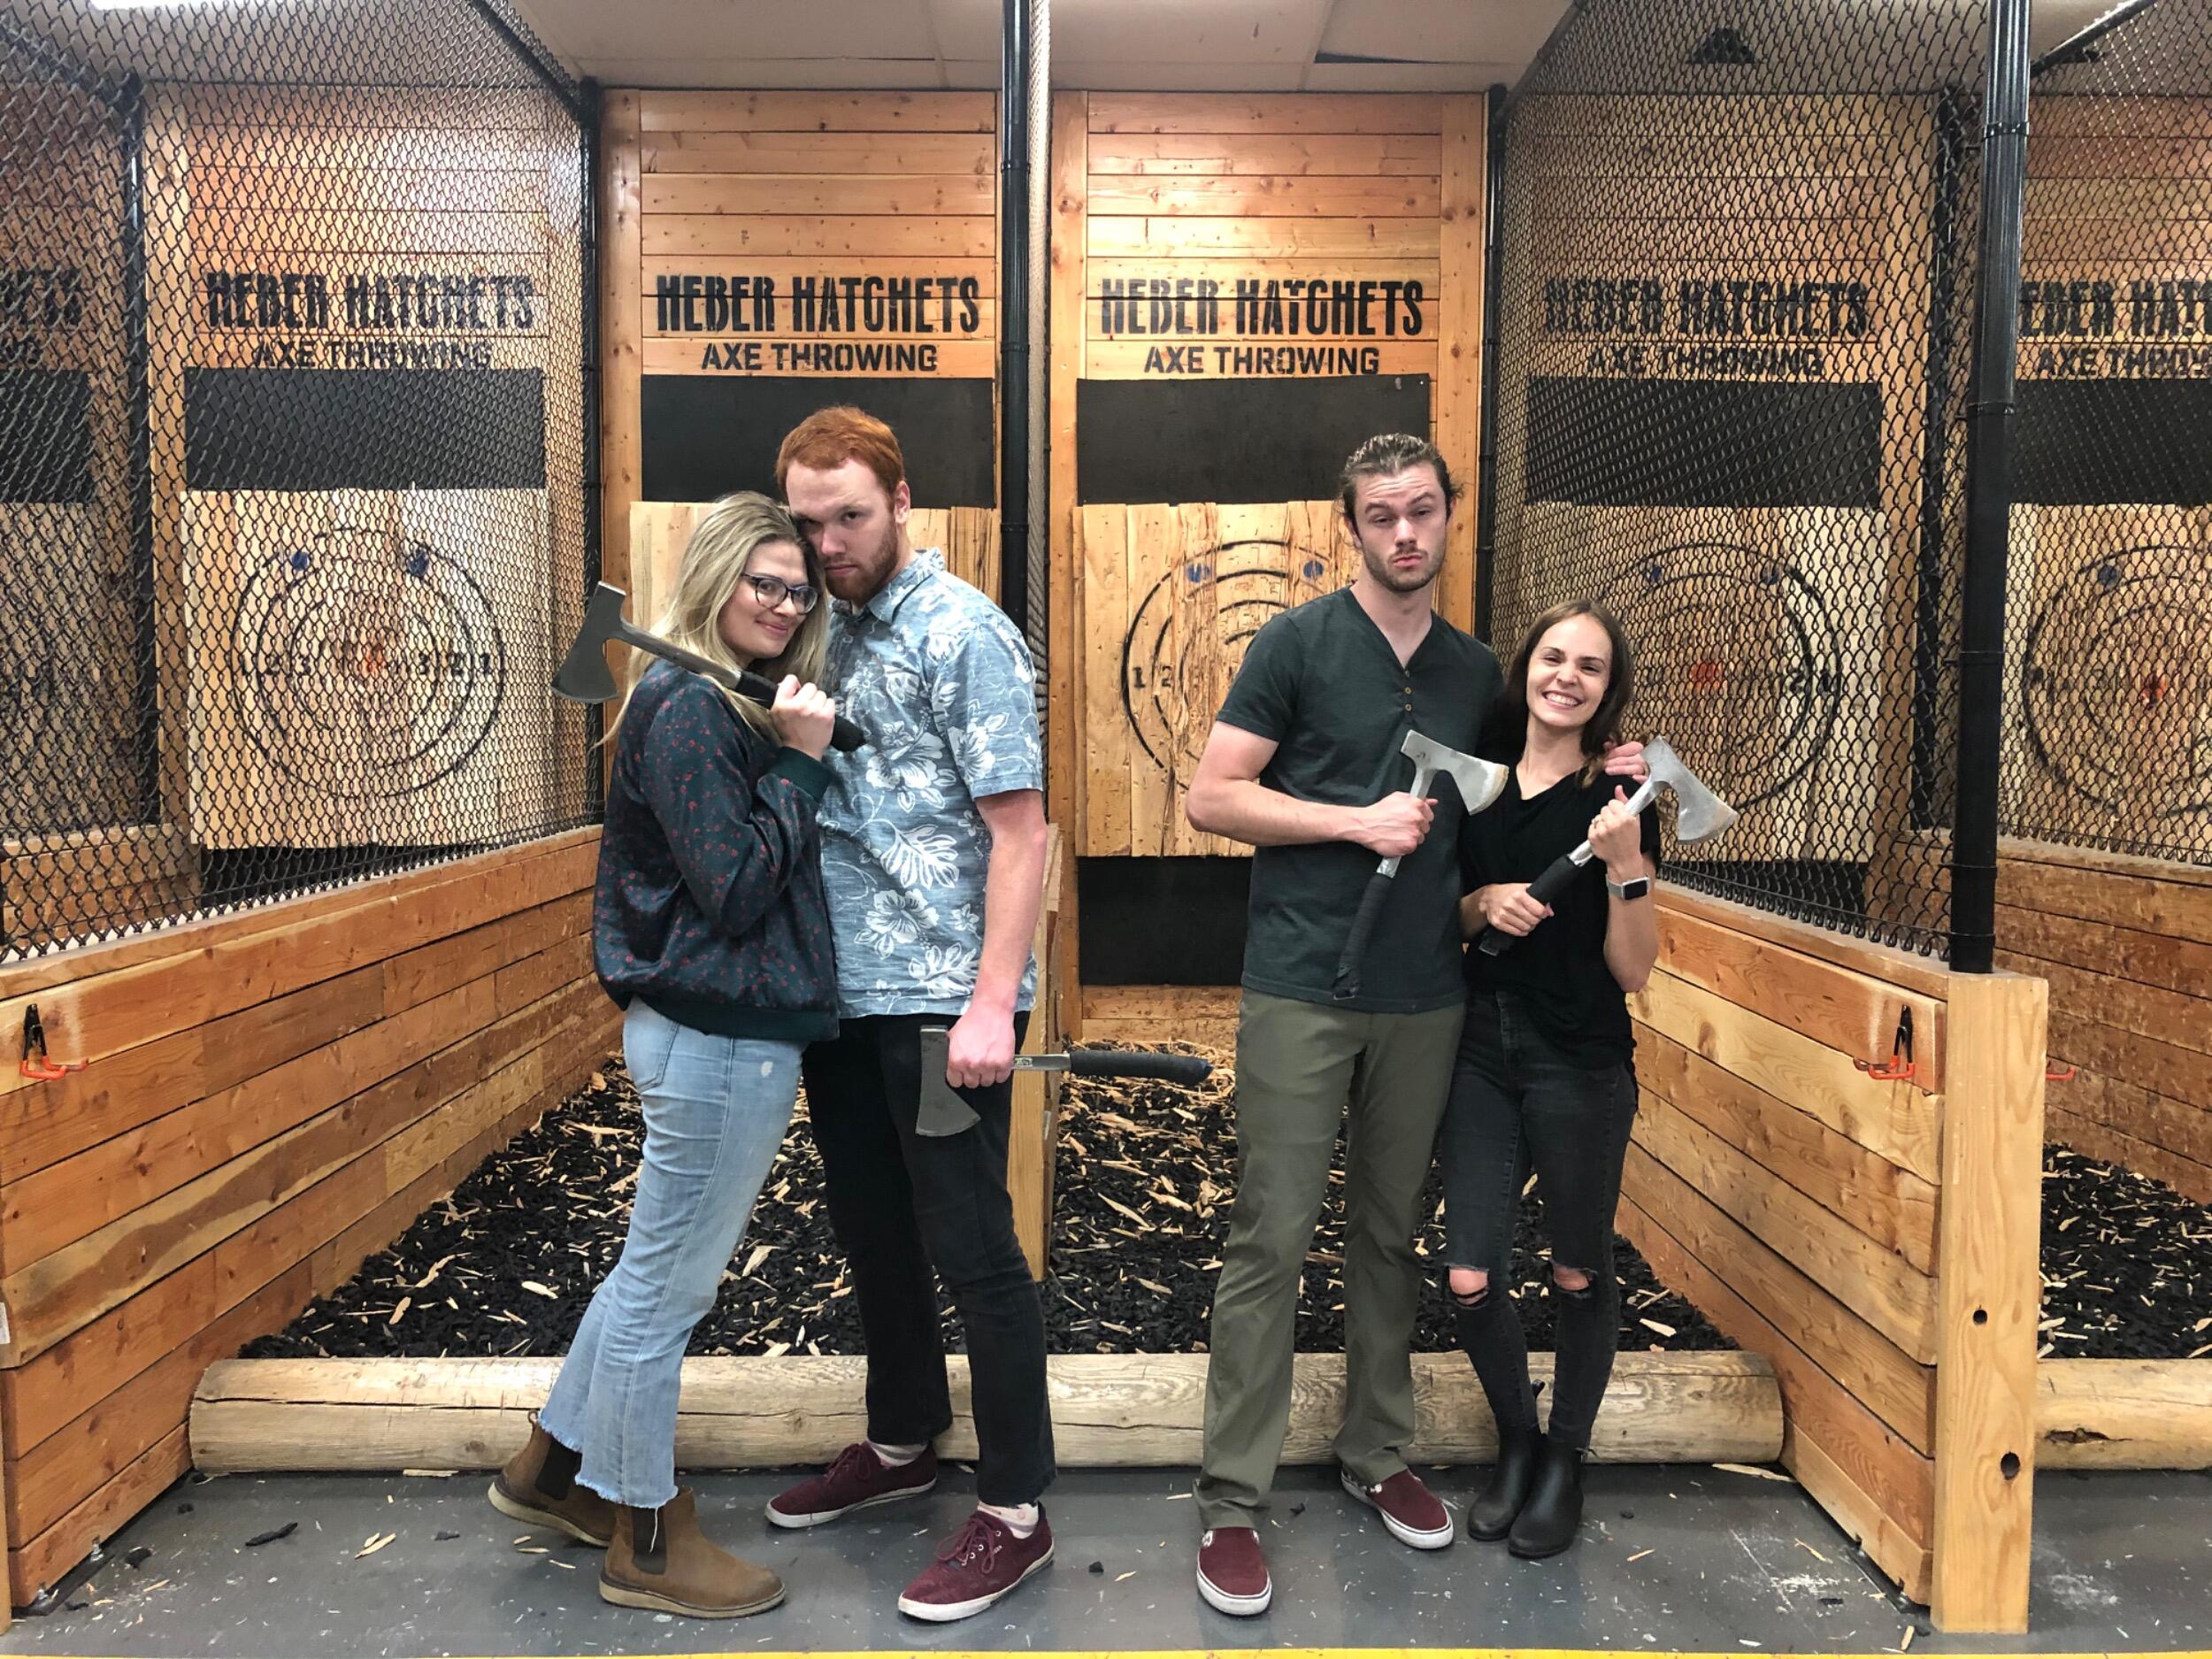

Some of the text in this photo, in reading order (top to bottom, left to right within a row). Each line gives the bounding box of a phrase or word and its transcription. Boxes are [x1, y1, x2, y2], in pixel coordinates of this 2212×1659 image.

[207, 273, 533, 329] HEBER HATCHETS
[657, 275, 980, 333] HEBER HATCHETS
[1102, 278, 1422, 335] HEBER HATCHETS
[1680, 279, 1867, 336] HATCHETS
[2020, 280, 2116, 336] EBER
[255, 340, 492, 369] AXE THROWING
[702, 342, 938, 372] AXE THROWING
[1144, 346, 1380, 375] AXE THROWING
[2038, 347, 2097, 376] AXE
[1133, 664, 1173, 689] 1 2
